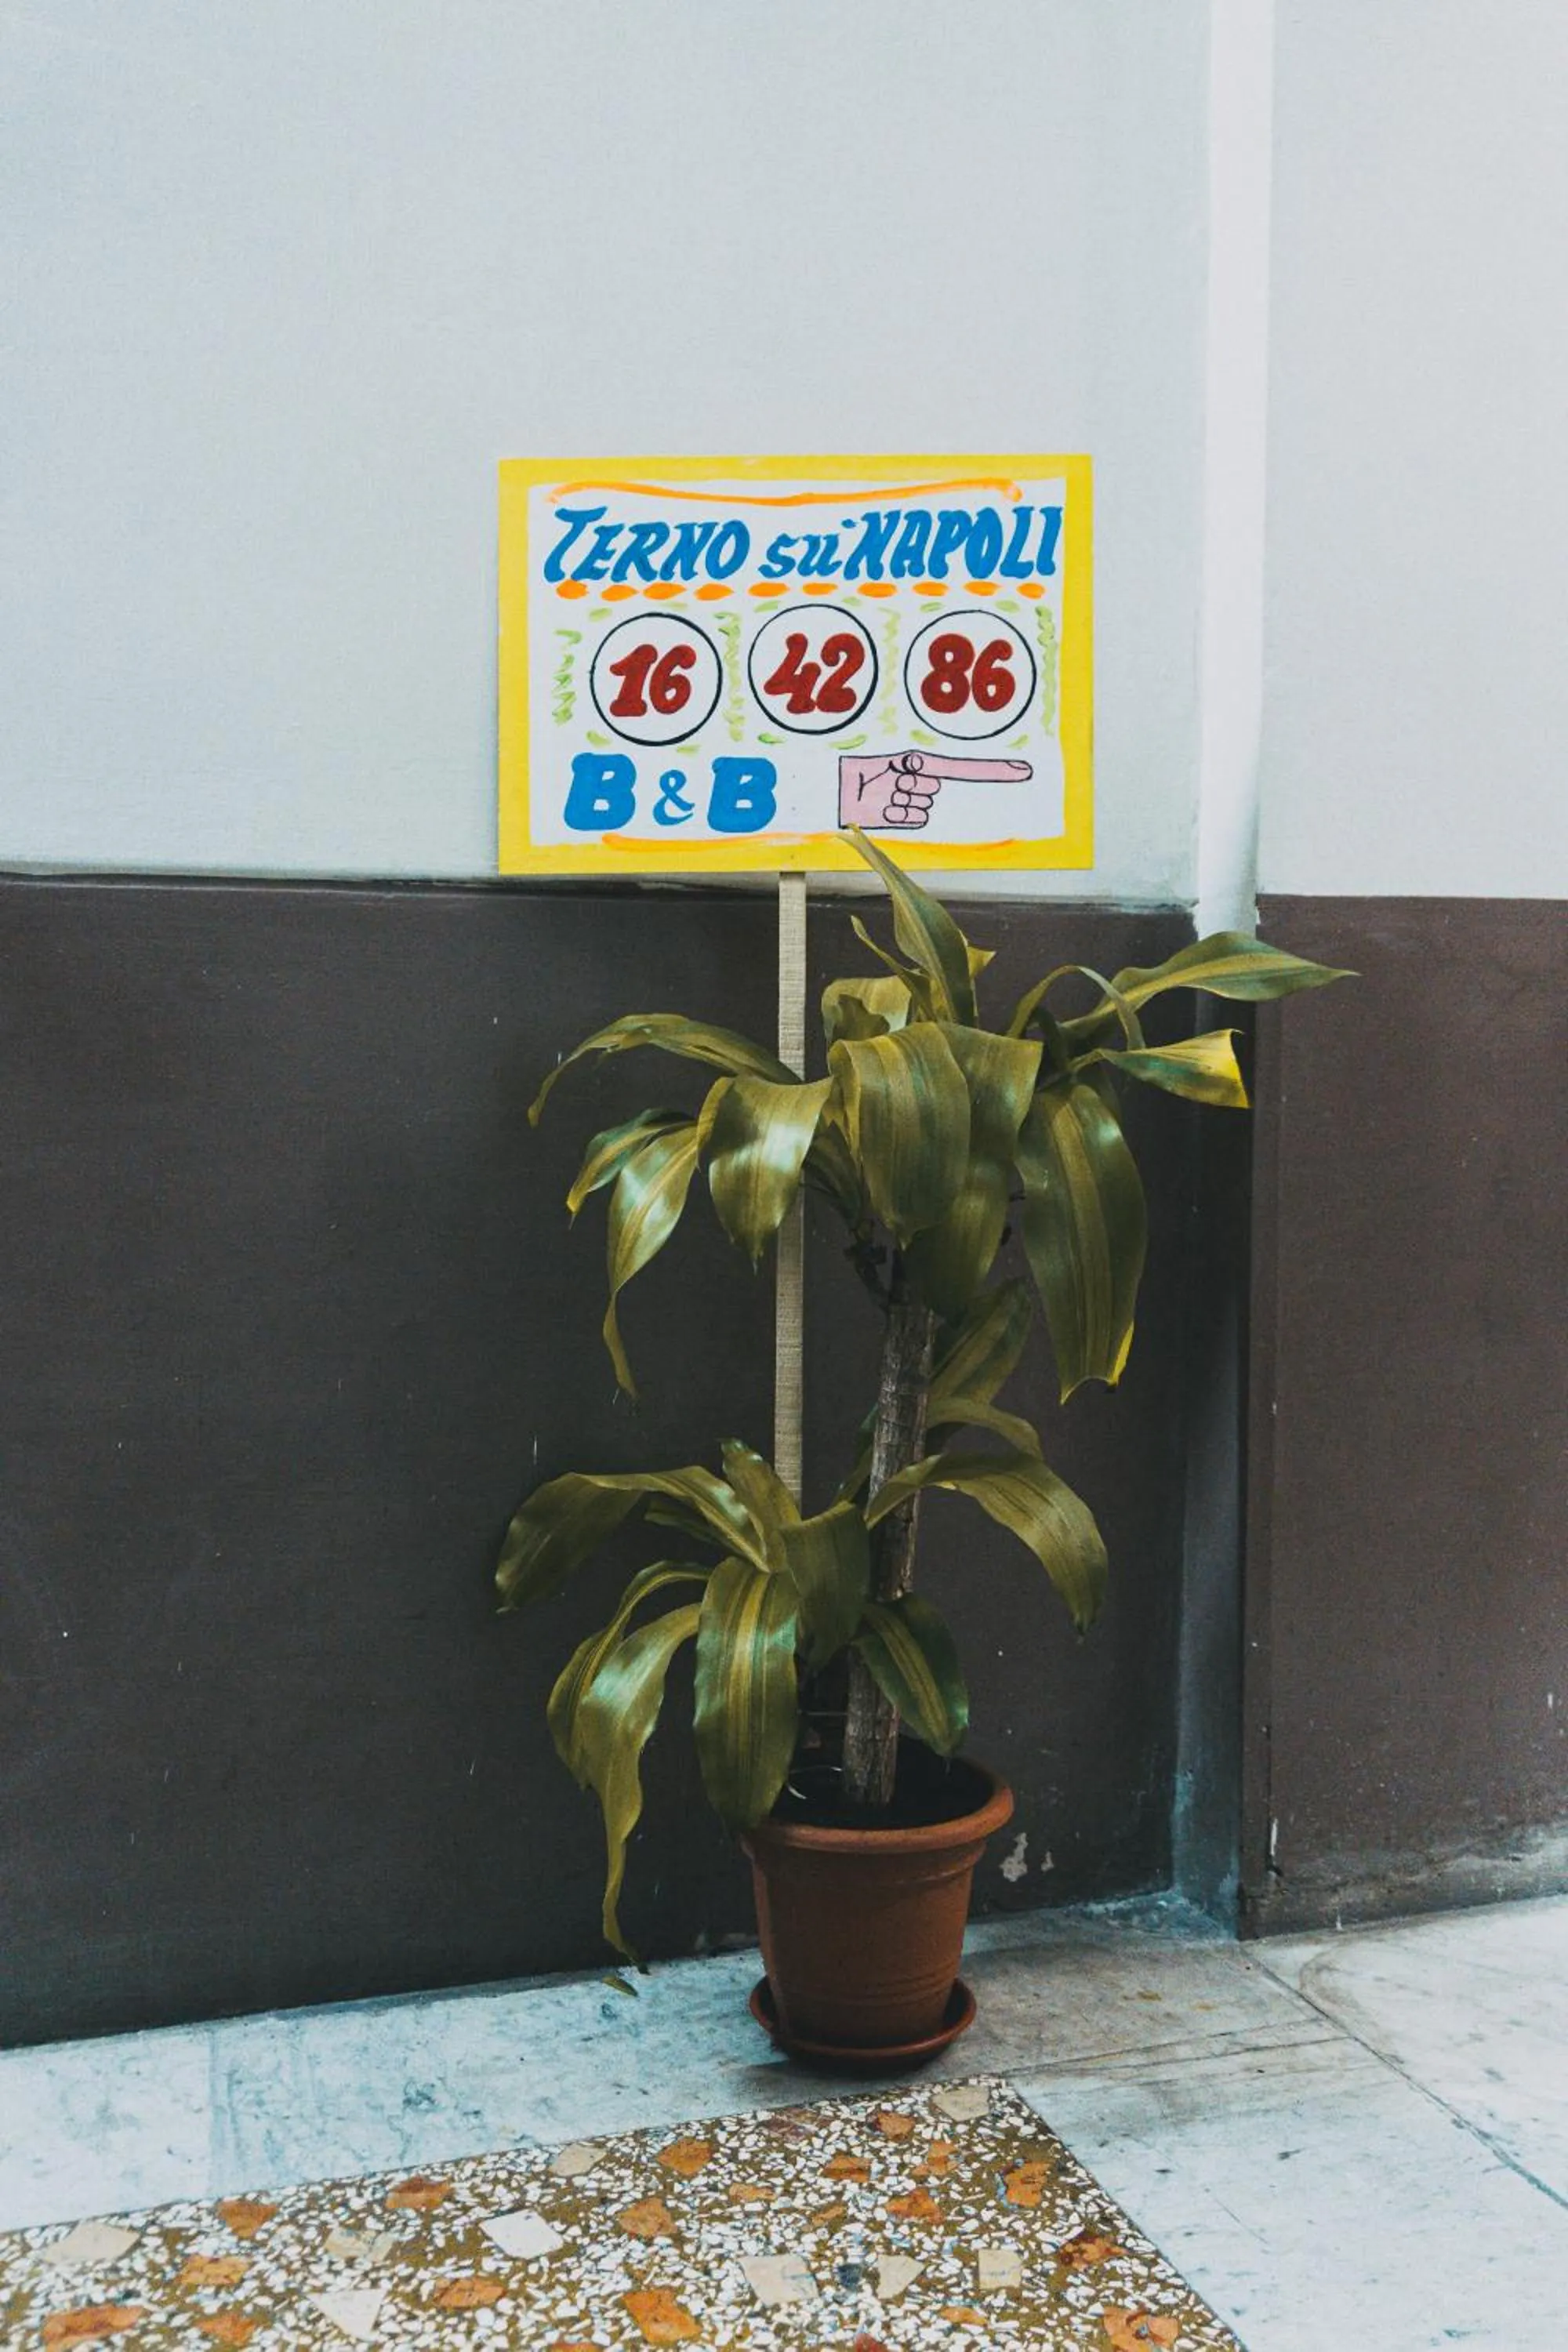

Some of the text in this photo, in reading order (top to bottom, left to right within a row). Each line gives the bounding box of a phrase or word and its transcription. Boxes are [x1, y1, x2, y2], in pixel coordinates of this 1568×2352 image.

[543, 506, 750, 583] TERNO
[843, 506, 1062, 581] NAPOLI
[610, 633, 1015, 717] 16 42 86
